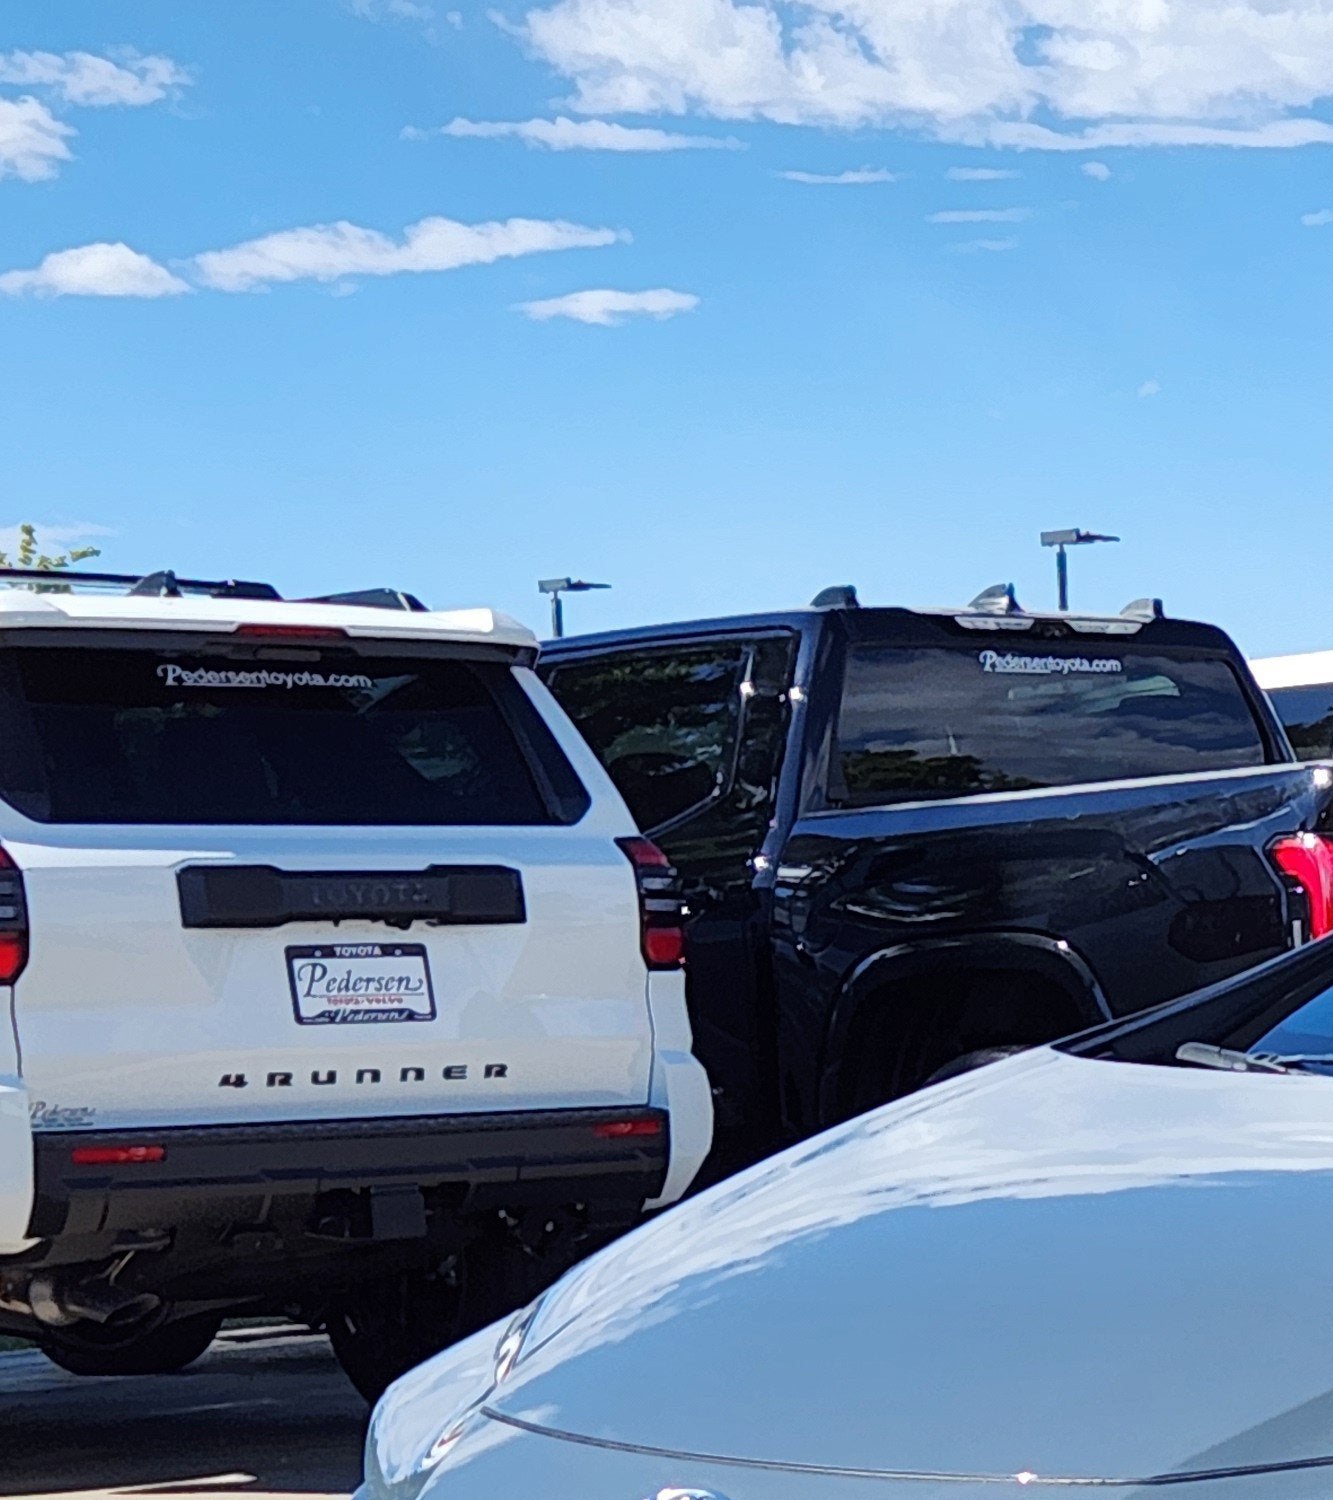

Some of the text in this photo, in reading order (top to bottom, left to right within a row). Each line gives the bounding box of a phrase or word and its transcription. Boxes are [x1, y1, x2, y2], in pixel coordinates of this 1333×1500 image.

[334, 946, 383, 957] TOYOTA
[298, 962, 424, 997] Pedersen
[219, 1063, 509, 1090] 4RUNNER
